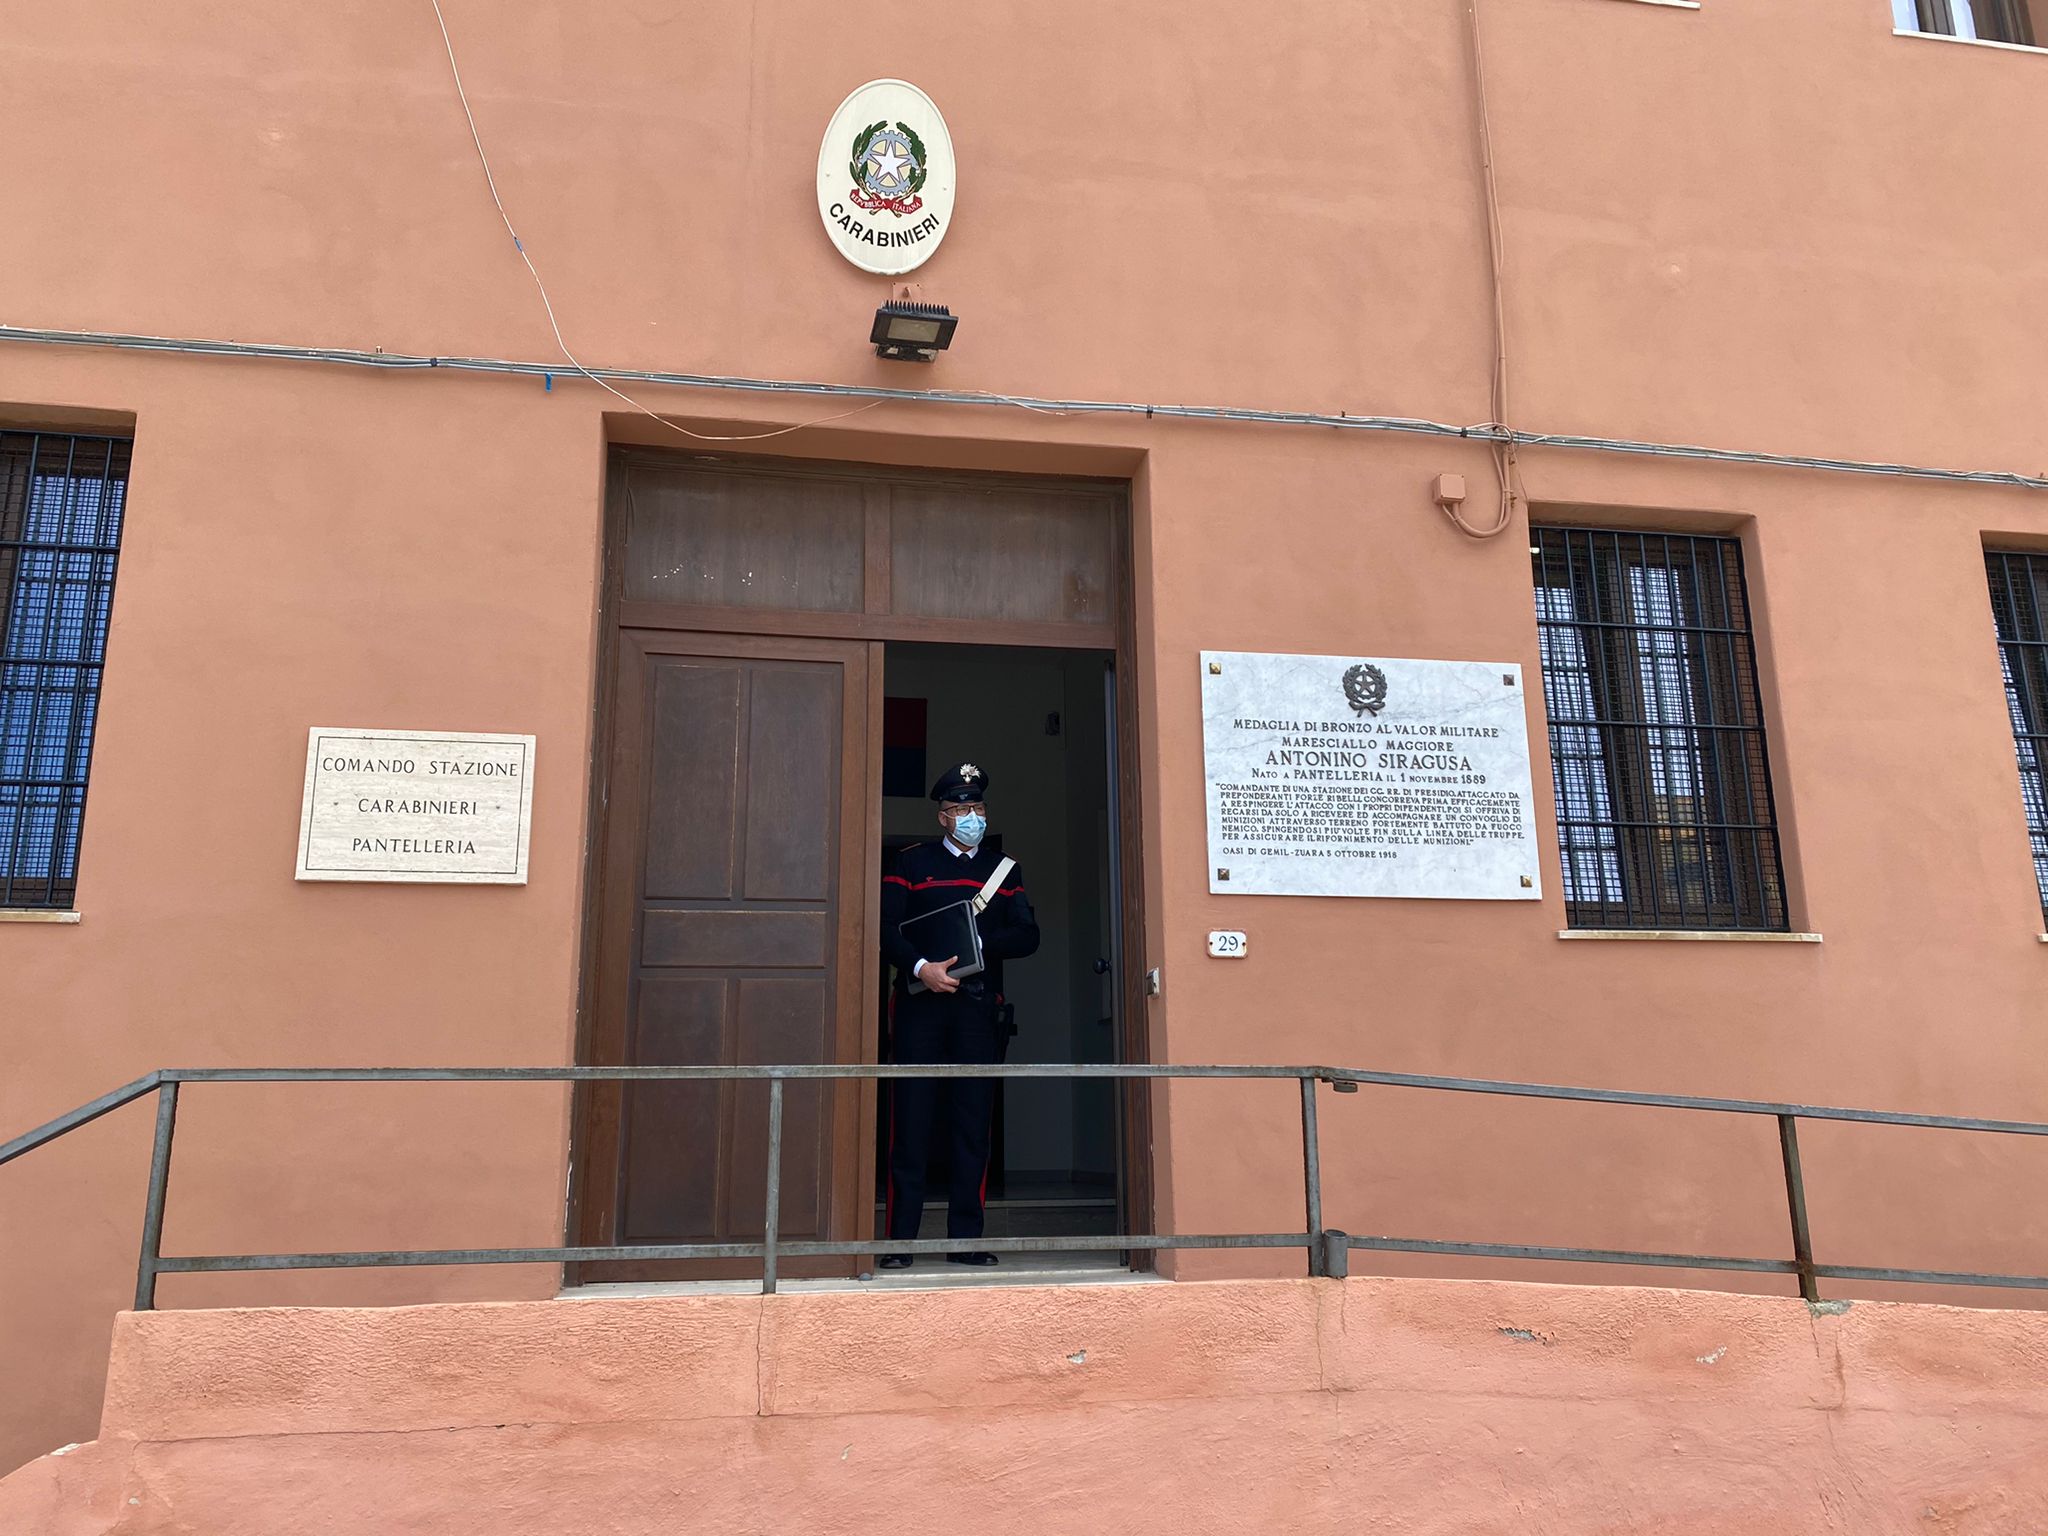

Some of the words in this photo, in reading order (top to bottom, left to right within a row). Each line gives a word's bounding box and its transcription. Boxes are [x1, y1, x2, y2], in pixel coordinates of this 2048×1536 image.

[892, 202, 921, 213] ITALIANA
[829, 203, 940, 247] CARABINIERI
[1233, 719, 1300, 731] MEDAGLIA
[1304, 721, 1317, 732] DI
[1321, 722, 1372, 734] BRONZO
[1376, 724, 1392, 734] AL
[1394, 725, 1437, 736] VALOR
[1440, 726, 1499, 738] MILITARE
[1282, 736, 1377, 749] MARESCIALLO
[1386, 740, 1454, 752] MAGGIORE
[322, 757, 415, 774] COMANDO
[428, 760, 518, 777] STAZIONE
[1265, 750, 1367, 768] ANTONINO
[1378, 753, 1472, 771] SIRAGUSA
[1294, 769, 1383, 782] PANTELLERIA
[1400, 772, 1406, 783] 1
[1461, 774, 1486, 785] 1889
[1220, 792, 1292, 801] PREPONDERANTI
[1295, 793, 1323, 801] FORZE
[1363, 795, 1420, 804] CONCORREVA
[1422, 797, 1448, 805] PRIMA
[1451, 798, 1520, 807] EFFICACEMENTE
[1282, 785, 1291, 793] DI
[1293, 785, 1309, 793] UNA
[1312, 786, 1352, 794] STAZIONE
[1354, 787, 1368, 795] DEI
[1403, 788, 1411, 796] DI
[1457, 790, 1506, 799] ATTACCATO
[358, 798, 477, 815] CARABINIERI
[1221, 800, 1227, 808] A
[1230, 800, 1284, 808] RESPINGERE
[1363, 803, 1392, 811] PROPRI
[1447, 806, 1461, 814] POI
[1464, 806, 1472, 814] SI
[1475, 807, 1510, 815] OFFRIVA
[1221, 808, 1259, 816] RECARSI
[1261, 809, 1273, 817] DA
[1275, 809, 1299, 817] SOLO
[1311, 810, 1353, 818] RICEVERE
[1356, 811, 1369, 819] ED
[1372, 812, 1442, 820] ACCOMPAGNARE
[1459, 814, 1510, 823] CONVOGLIO
[1513, 815, 1521, 823] DI
[1221, 816, 1265, 824] MUNIZIONI
[1269, 817, 1326, 826] ATTRAVERSO
[1328, 819, 1369, 827] TERRENO
[1372, 820, 1429, 828] FORTEMENTE
[1433, 821, 1472, 830] BATTUTO
[1491, 823, 1522, 831] FUOCO
[1222, 832, 1239, 840] PER
[1243, 833, 1304, 842] ASSICURARE
[1388, 836, 1419, 844] DELLE
[1261, 825, 1321, 834] SPINGENDOSI
[1373, 828, 1388, 836] FIN
[1391, 828, 1422, 837] SULLA
[1425, 829, 1454, 838] LINEA
[1456, 830, 1486, 838] DELLE
[352, 837, 476, 854] PANTELLERIA
[1222, 847, 1243, 855] OASI
[1248, 847, 1256, 855] DI
[1326, 849, 1331, 857] 5
[1334, 849, 1376, 858] OTTOBRE
[1218, 935, 1239, 952] 29
